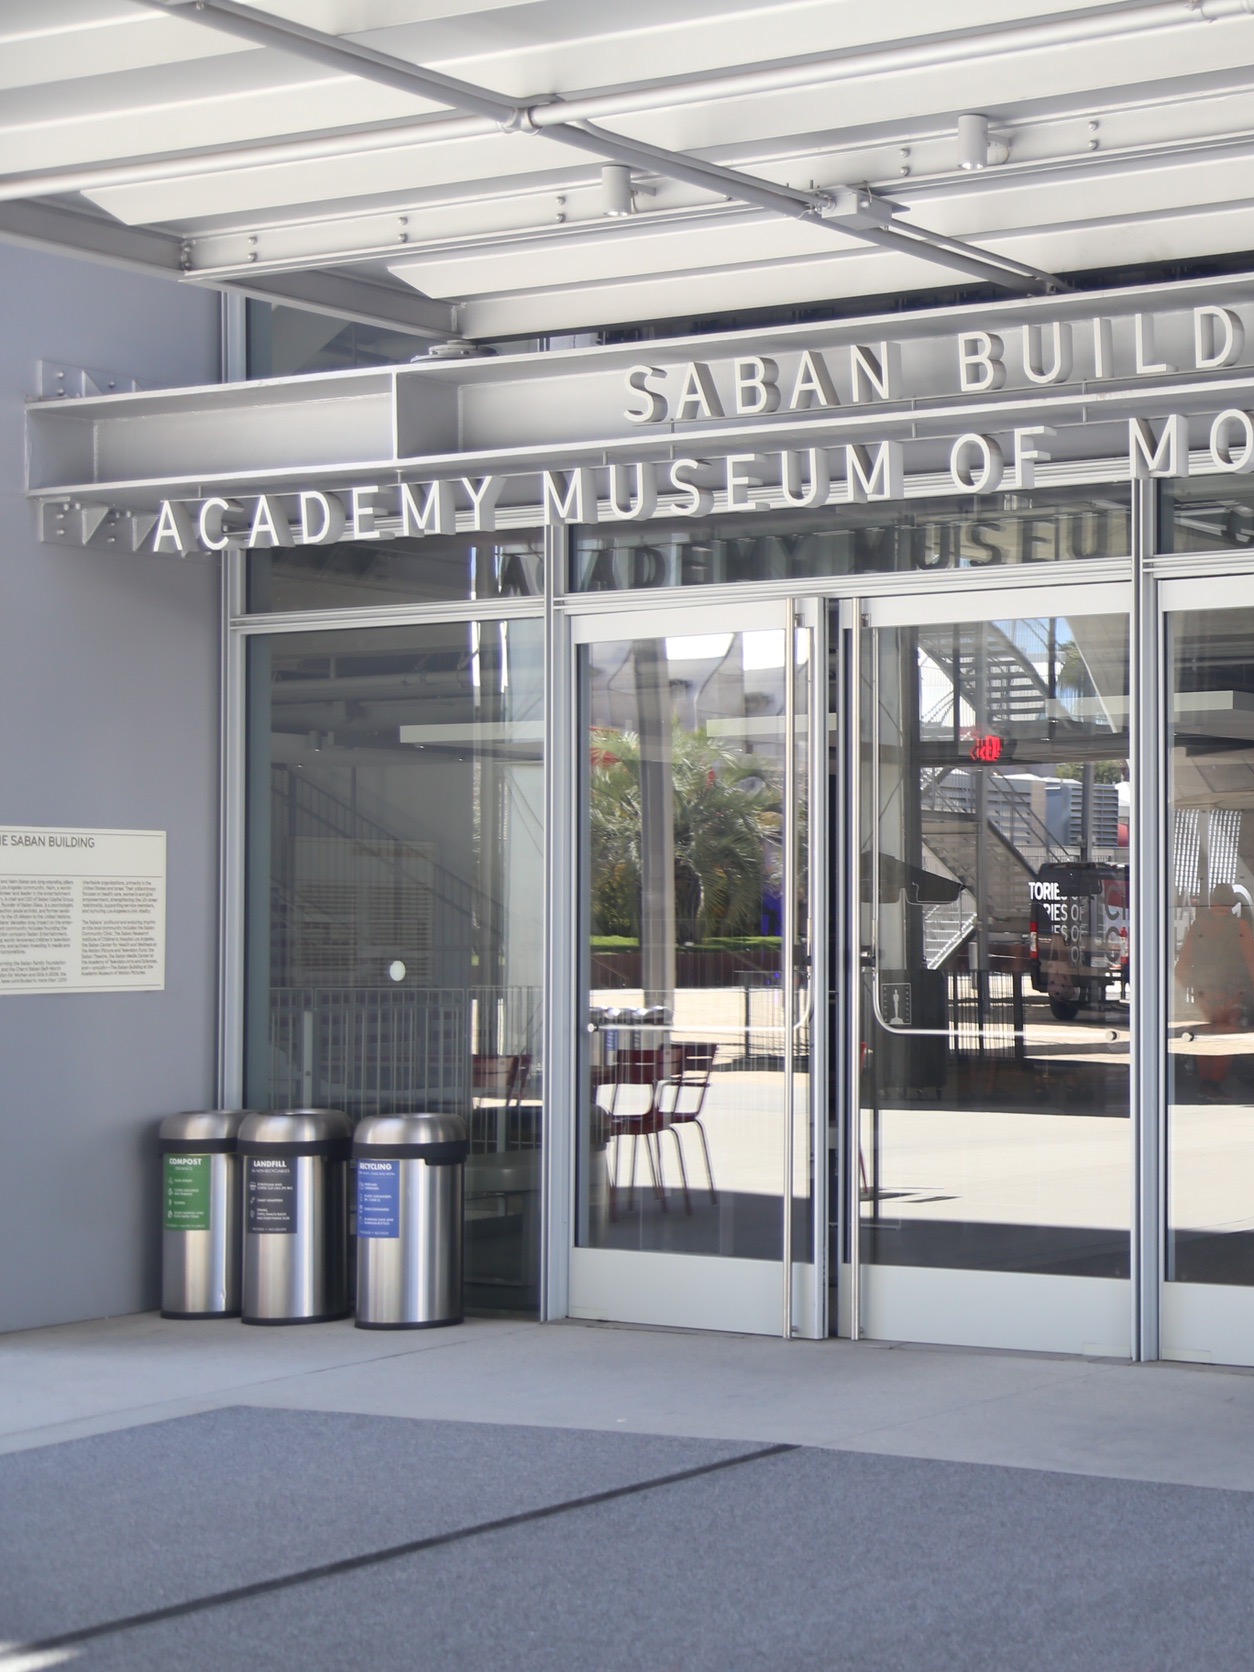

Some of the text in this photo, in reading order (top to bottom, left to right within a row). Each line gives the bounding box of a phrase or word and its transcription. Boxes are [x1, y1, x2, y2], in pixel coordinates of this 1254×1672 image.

[623, 340, 900, 423] SABAN
[152, 475, 506, 554] ACADEMY
[542, 439, 904, 525] MUSEUM
[950, 425, 1057, 495] OF
[10, 835, 46, 847] SABAN
[49, 836, 95, 848] BUILDING
[169, 1157, 202, 1166] COMPOST
[253, 1160, 287, 1168] LANDFILL
[359, 1162, 393, 1171] RECYCLING
